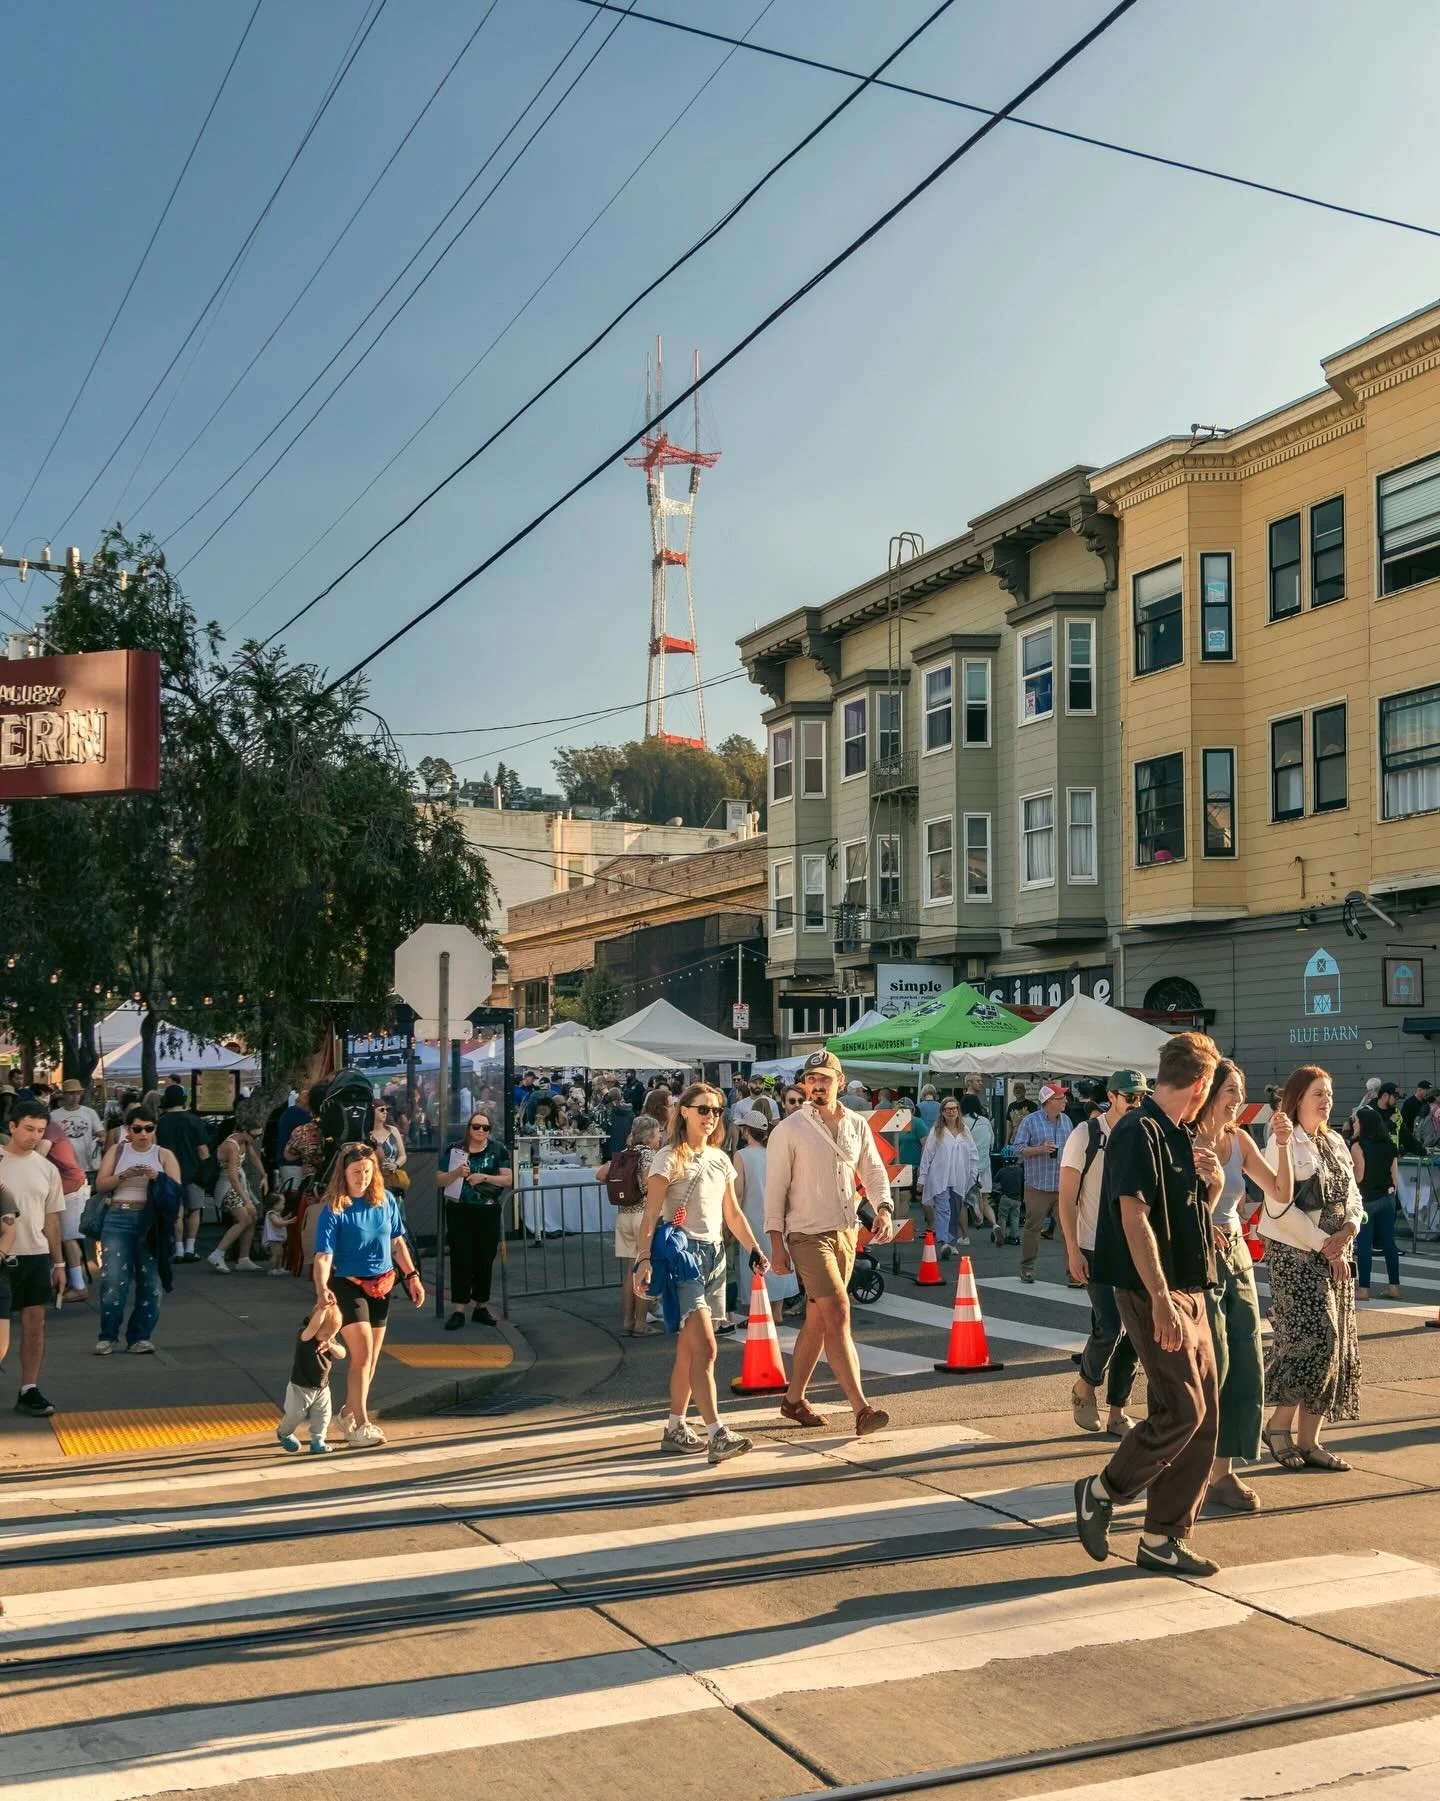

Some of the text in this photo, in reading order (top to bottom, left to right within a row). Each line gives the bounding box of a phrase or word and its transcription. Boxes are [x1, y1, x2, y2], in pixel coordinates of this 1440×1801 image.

[890, 980, 942, 994] simple
[990, 974, 1111, 1007] simple
[1290, 1025, 1360, 1043] BLUE BARN
[841, 1042, 868, 1052] RENEWAL
[873, 1040, 905, 1050] ANDERSEN
